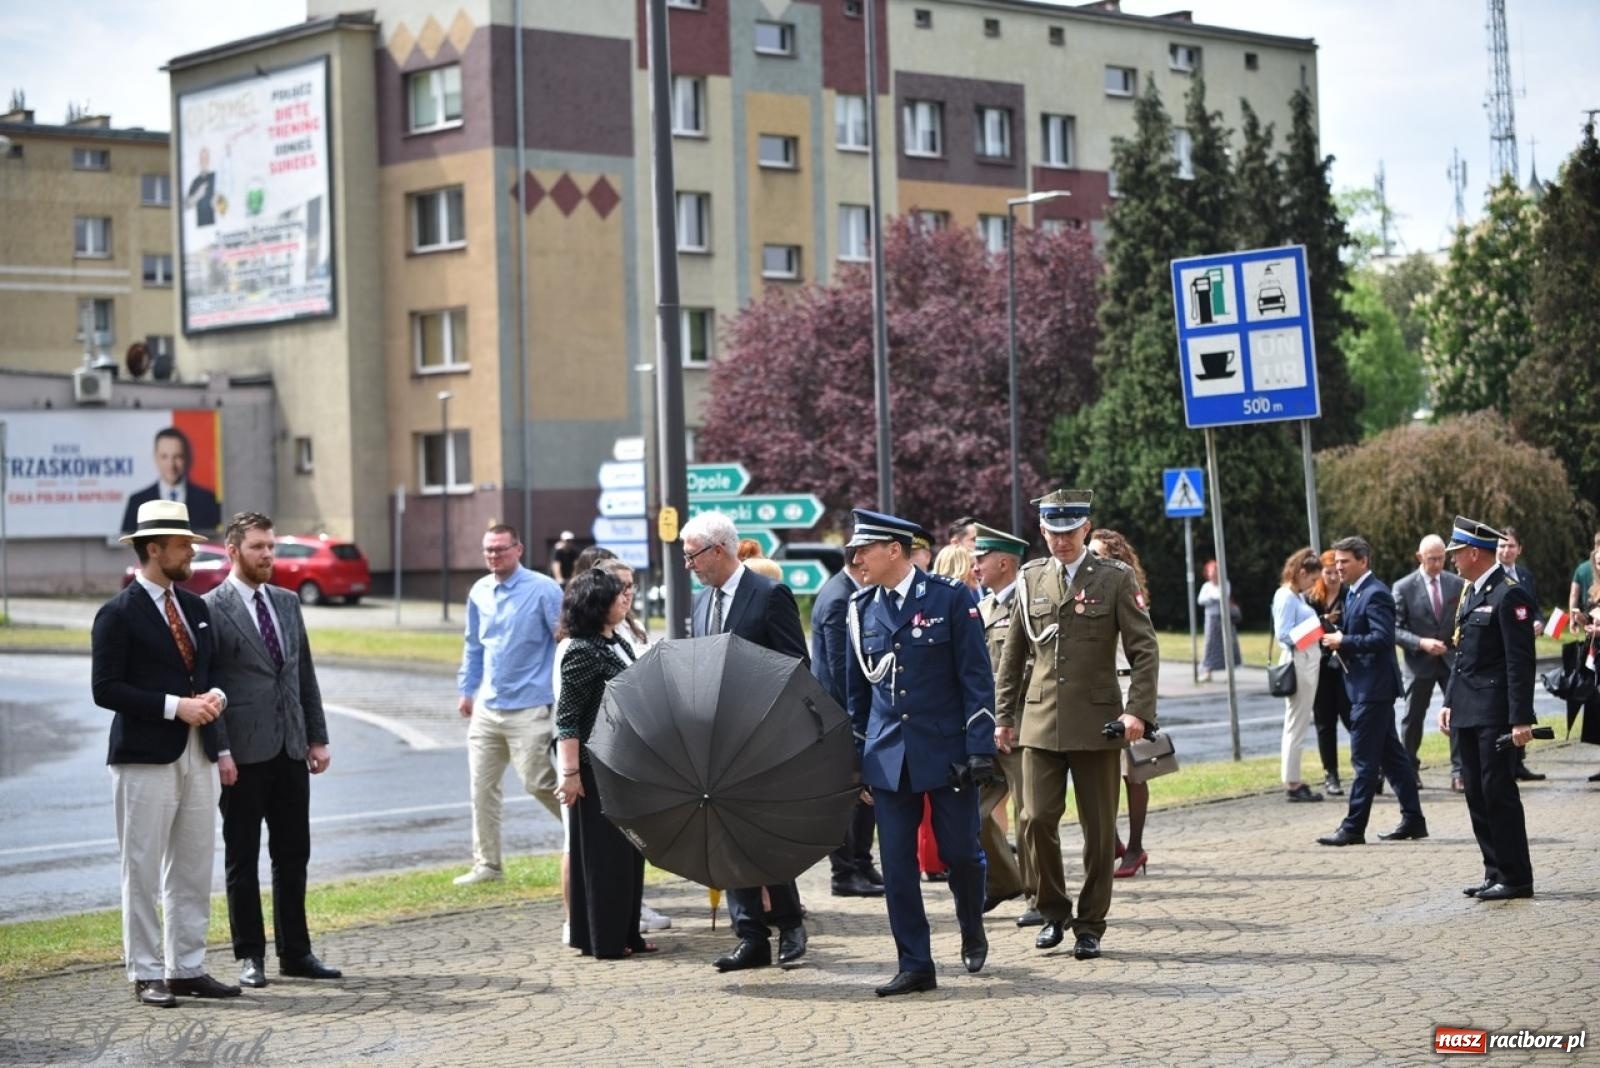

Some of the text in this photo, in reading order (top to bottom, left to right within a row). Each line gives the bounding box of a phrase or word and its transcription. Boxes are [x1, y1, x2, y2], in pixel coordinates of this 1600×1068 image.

[1243, 397, 1284, 415] 500 m
[687, 472, 731, 492] Opole
